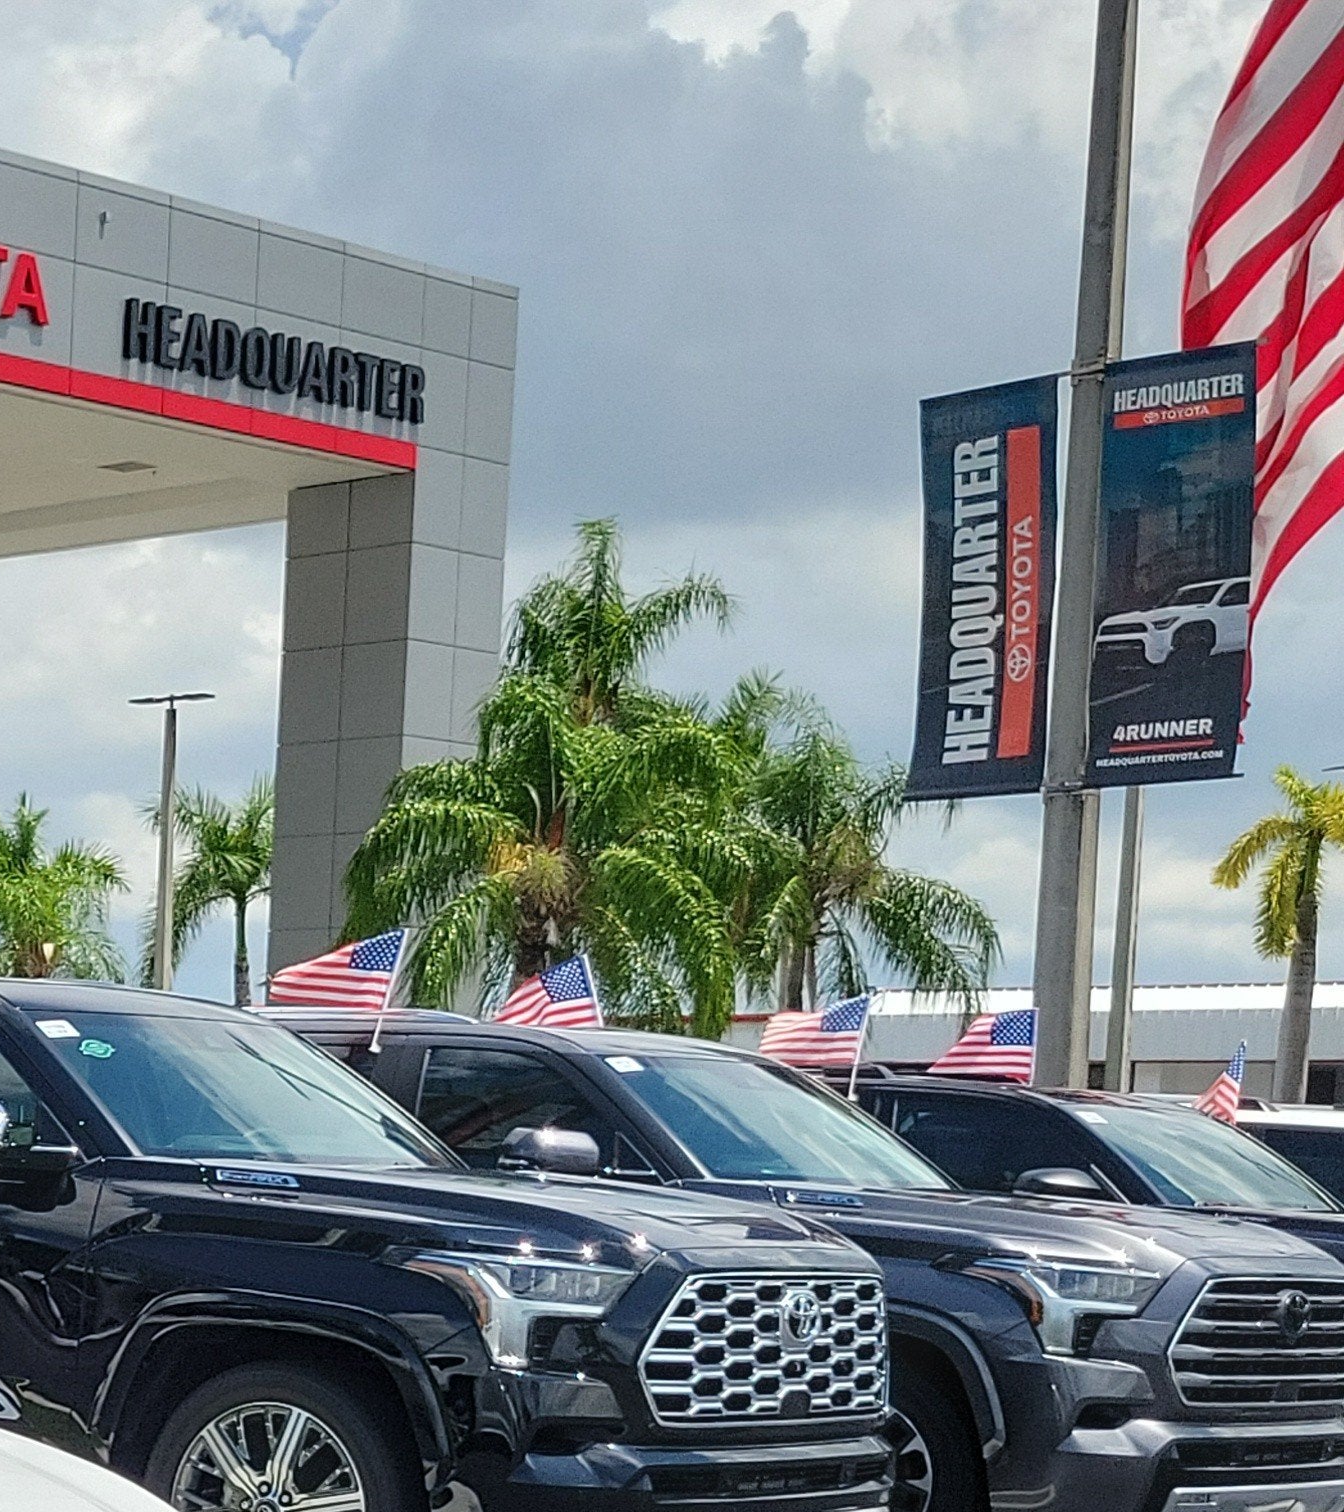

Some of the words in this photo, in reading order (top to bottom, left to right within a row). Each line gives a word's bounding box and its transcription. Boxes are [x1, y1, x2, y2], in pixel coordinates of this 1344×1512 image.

[122, 297, 426, 425] HEADQUARTER
[1113, 373, 1245, 413] HEADQUARTER
[1161, 404, 1210, 421] TOYOTA
[1010, 514, 1033, 640] TOYOTA
[942, 433, 1005, 766] HEADQUARTER
[1112, 718, 1213, 742] 4RUNNER
[1095, 749, 1224, 768] HEADQUARTERTOYOTA.COM
